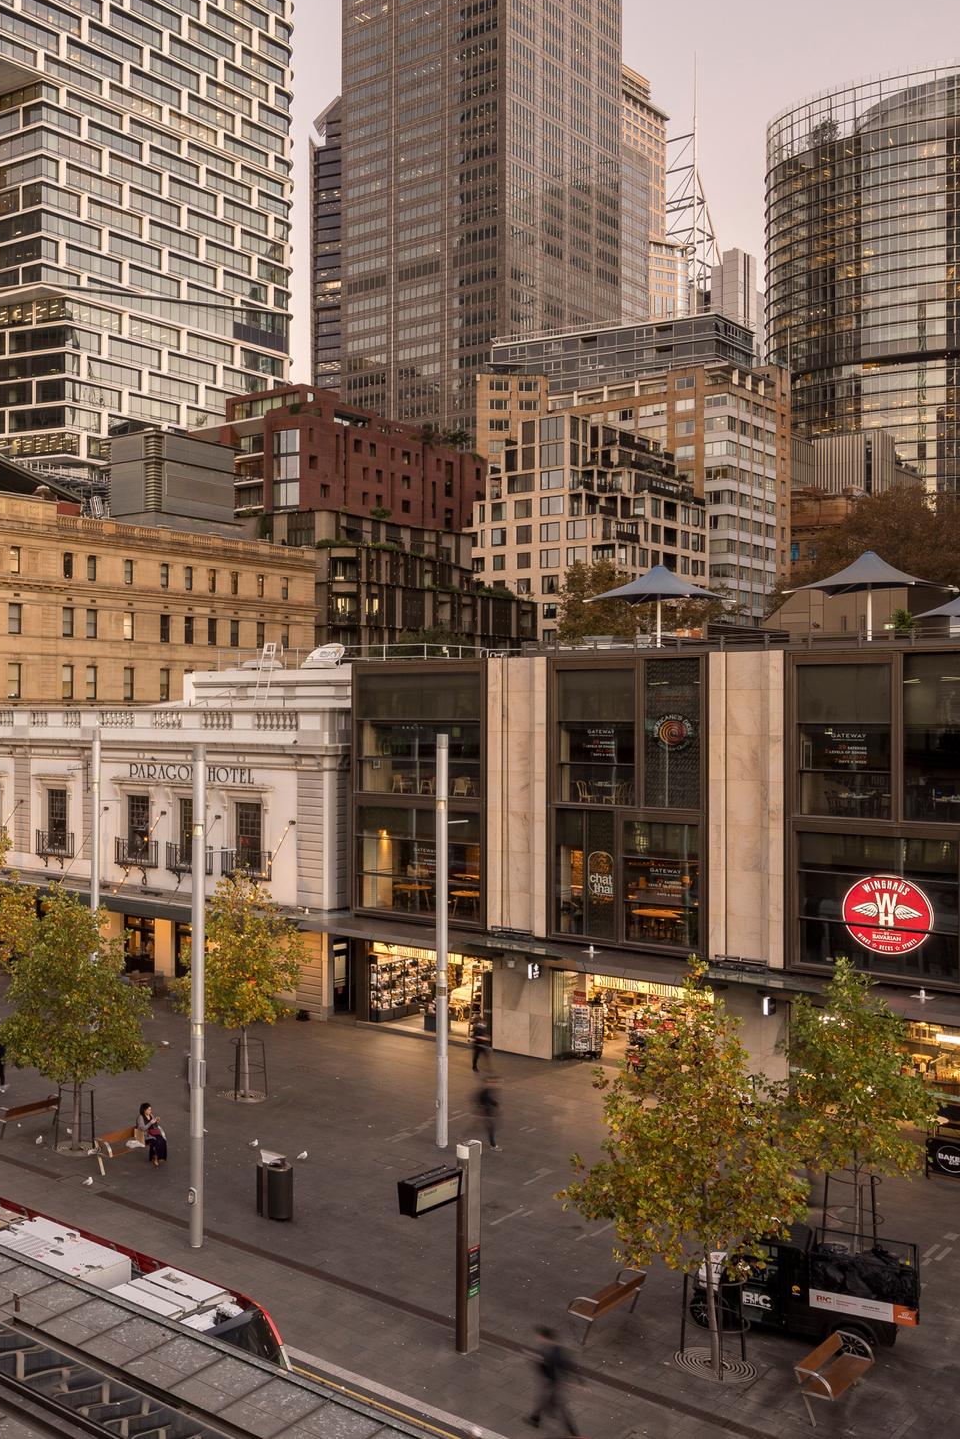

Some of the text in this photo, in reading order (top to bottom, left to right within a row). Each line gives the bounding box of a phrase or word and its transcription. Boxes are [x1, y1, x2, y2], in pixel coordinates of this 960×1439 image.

[129, 763, 255, 784] PARAGO HOTEL
[650, 867, 681, 875] GATEWAY
[590, 873, 613, 885] chat
[593, 883, 613, 894] thai
[862, 880, 910, 895] WINGHAÜS
[902, 938, 917, 949] SPORTS
